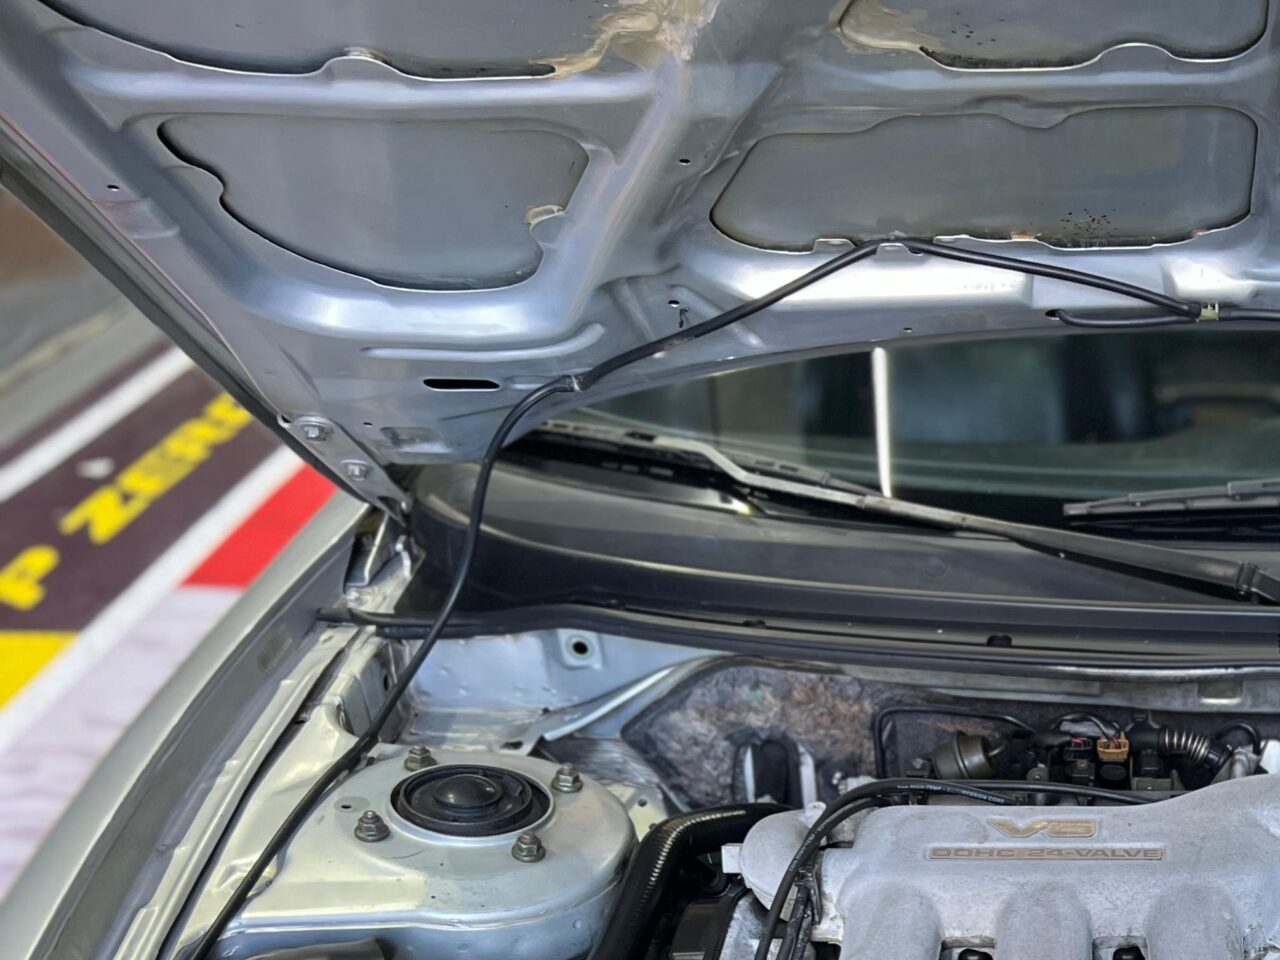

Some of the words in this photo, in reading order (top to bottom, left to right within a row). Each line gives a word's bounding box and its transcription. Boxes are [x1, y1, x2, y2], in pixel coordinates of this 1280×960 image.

[989, 818, 1096, 838] V6
[931, 847, 1017, 858] DOHC
[1027, 847, 1162, 859] 24-VALVE
